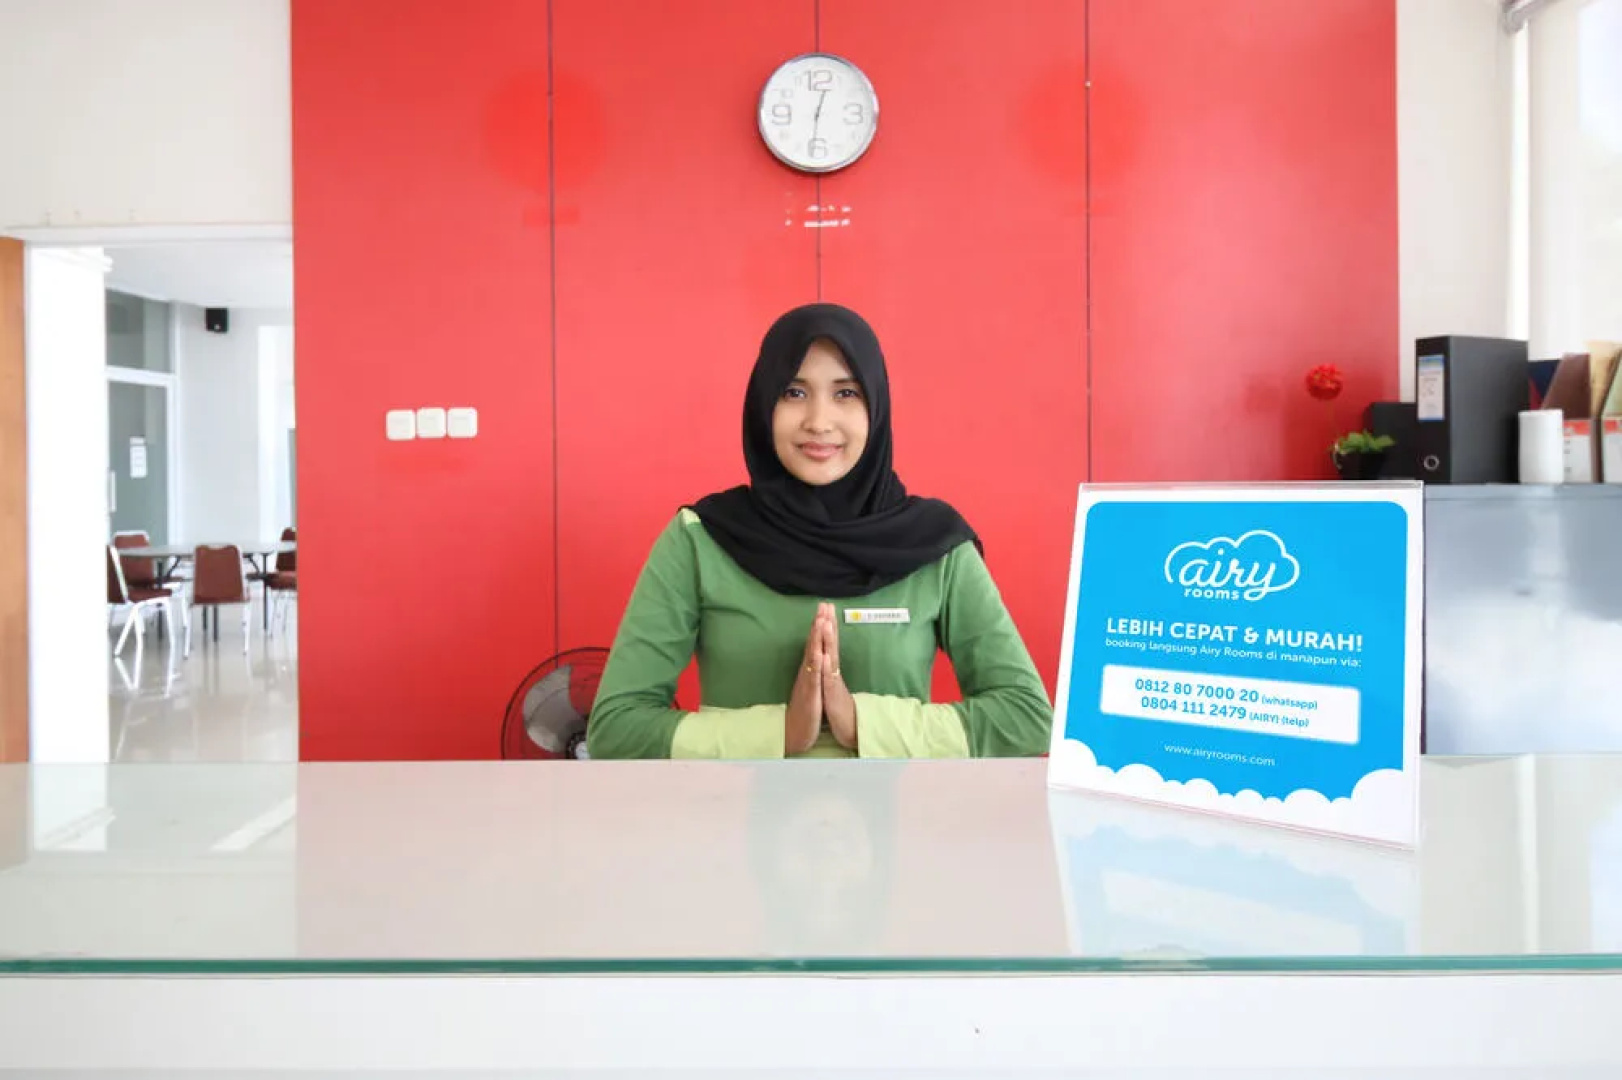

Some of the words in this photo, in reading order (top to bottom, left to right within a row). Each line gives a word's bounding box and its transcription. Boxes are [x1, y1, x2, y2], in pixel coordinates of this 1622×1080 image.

[804, 69, 832, 91] 12
[772, 104, 792, 125] 9
[843, 102, 863, 125] 3
[1179, 548, 1276, 601] airy
[1184, 588, 1240, 600] rooms
[1107, 617, 1164, 637] LEBIH
[1170, 622, 1238, 642] CEPAT
[1244, 626, 1259, 644] &
[1265, 628, 1363, 652] MURAH!
[1105, 638, 1145, 651] booking
[1149, 640, 1198, 655] langsung
[1200, 645, 1222, 657] Airy
[1224, 647, 1263, 659] Rooms
[1266, 650, 1278, 660] di
[1281, 652, 1337, 666] manapun
[1341, 657, 1362, 667] via:
[1135, 678, 1169, 693] 0812
[1173, 682, 1192, 695] 80
[1197, 684, 1235, 700] 7000
[1239, 689, 1260, 703] 20
[1261, 695, 1318, 710] (whatsapp)
[1141, 696, 1177, 711] 0804
[1182, 701, 1206, 714] 111
[1209, 704, 1247, 719] 2479
[1249, 711, 1279, 724] (AIRY)
[1281, 716, 1309, 728] (telp)
[1164, 744, 1276, 766] www.airyrooms.com
